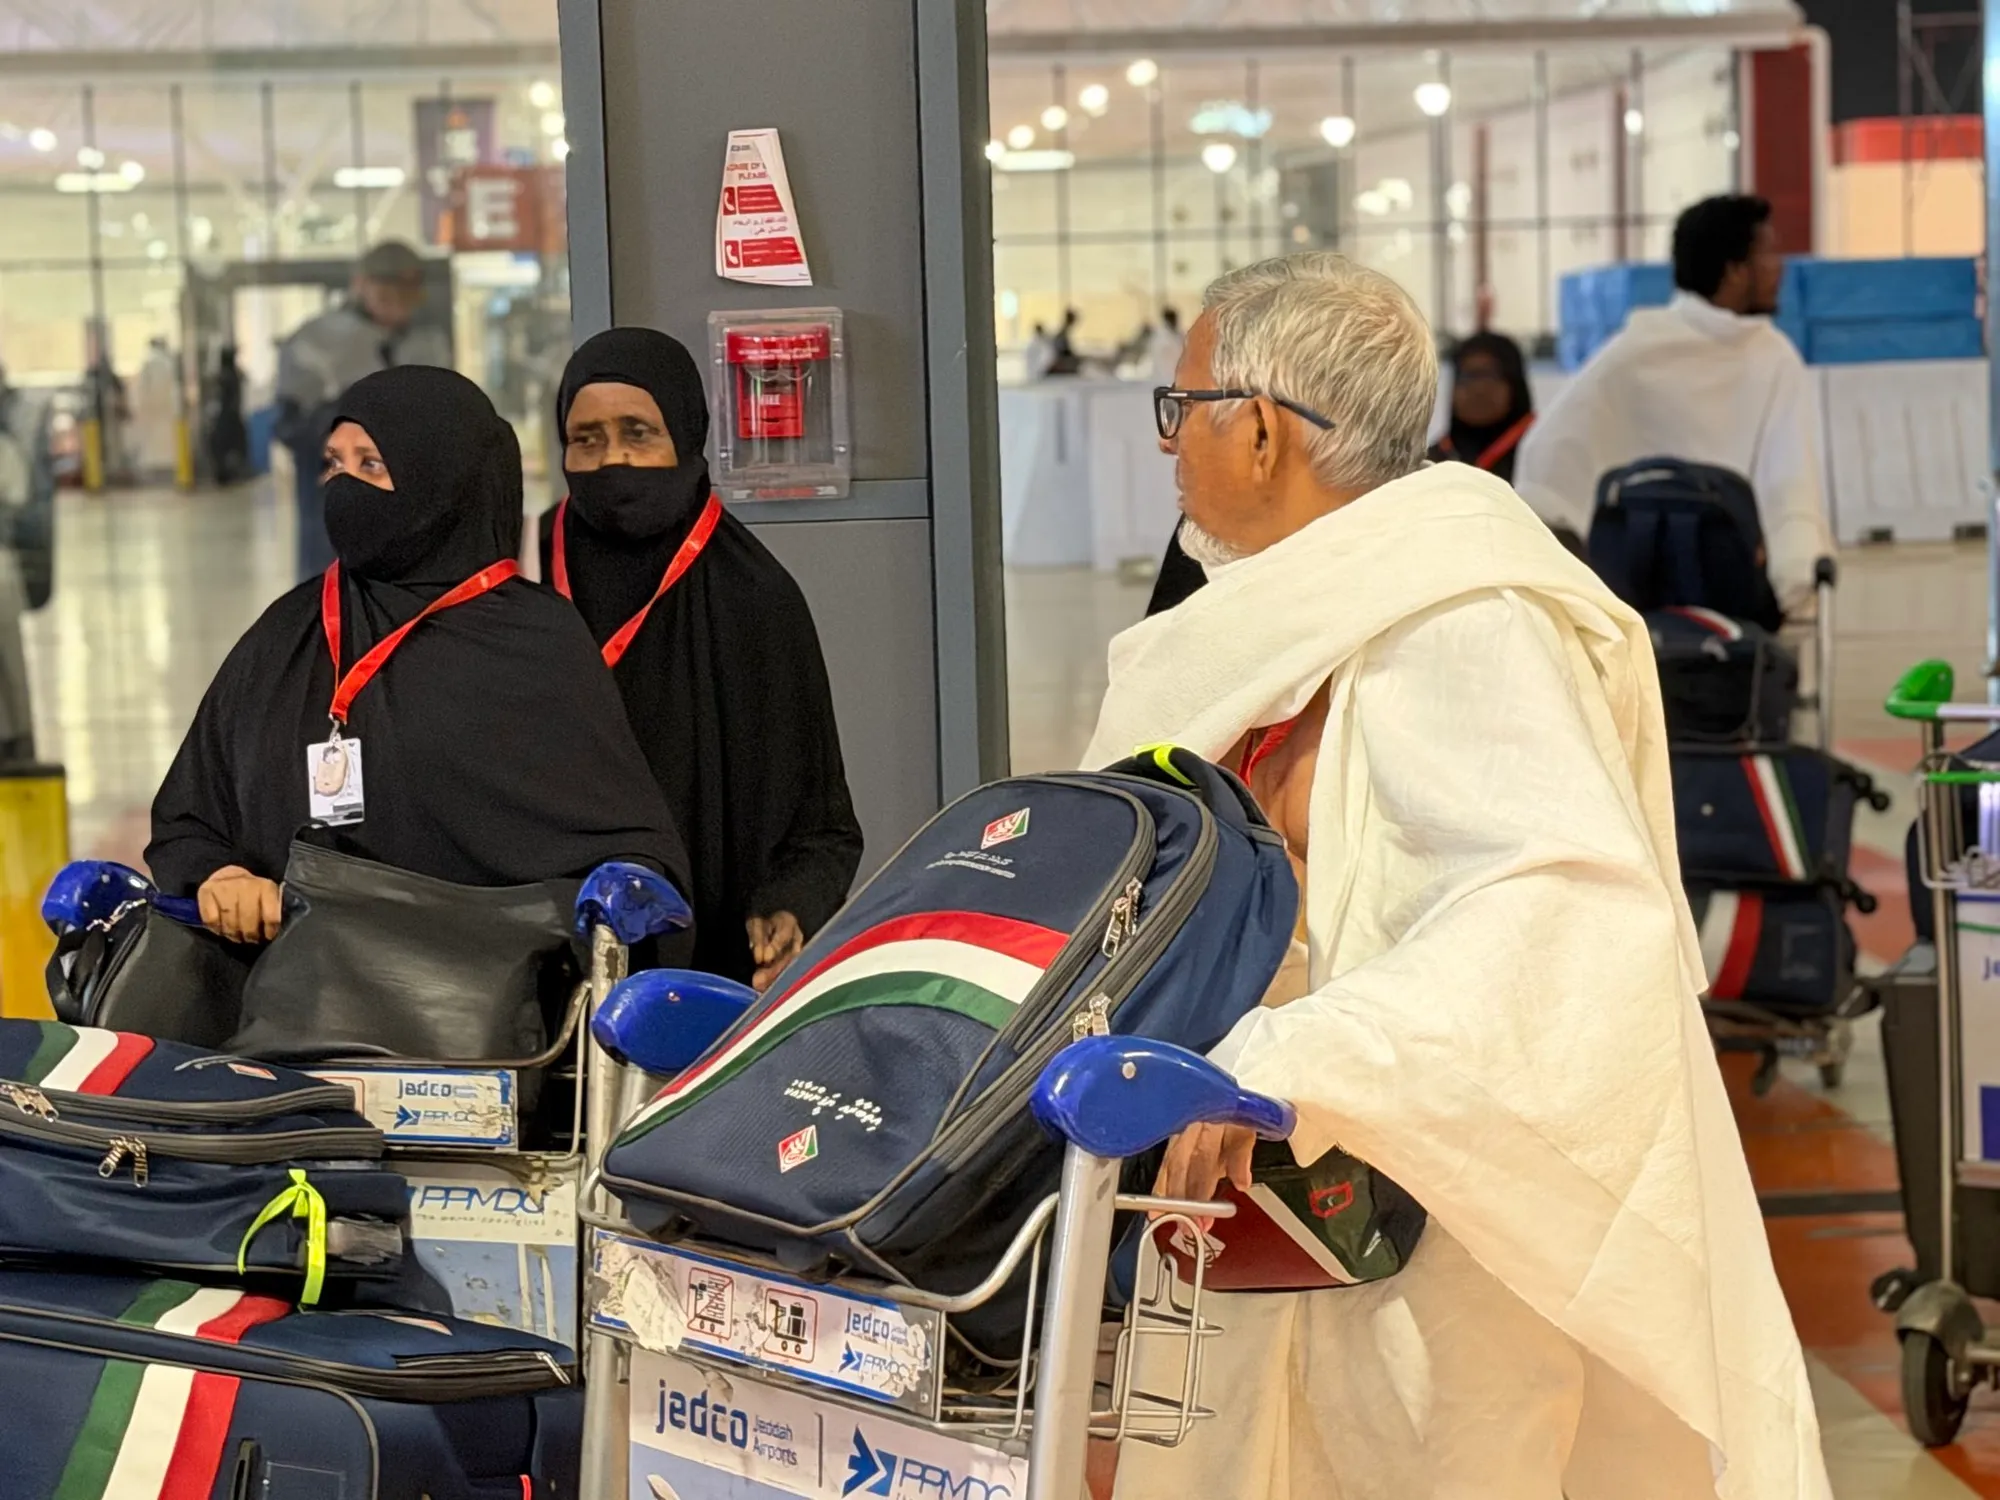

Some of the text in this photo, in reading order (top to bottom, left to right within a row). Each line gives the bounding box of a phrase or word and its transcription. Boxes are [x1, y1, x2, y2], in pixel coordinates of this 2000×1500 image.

[655, 1379, 748, 1450] jedco
[752, 1415, 793, 1441] Jeddah
[752, 1436, 798, 1466] Airports
